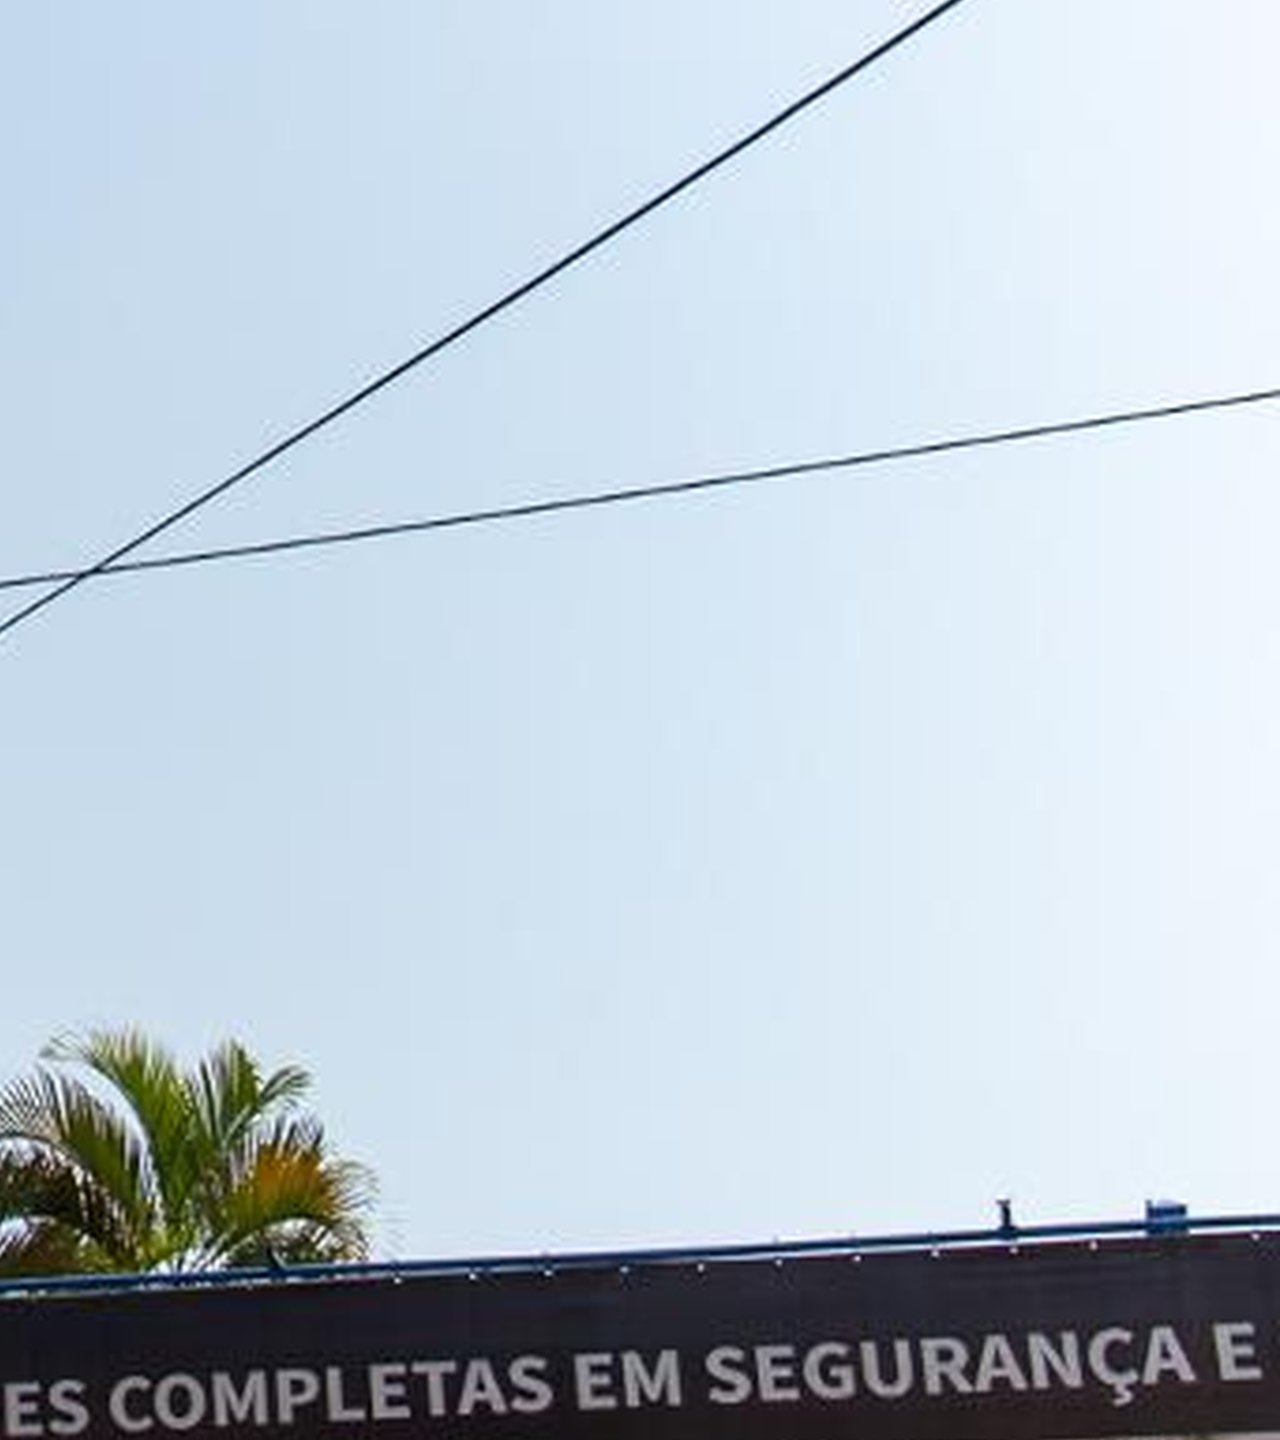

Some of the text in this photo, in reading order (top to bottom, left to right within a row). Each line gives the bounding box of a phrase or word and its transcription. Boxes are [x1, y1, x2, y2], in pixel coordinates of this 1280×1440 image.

[108, 1355, 554, 1431] COMPLETAS
[573, 1349, 683, 1411] EM
[705, 1326, 1197, 1406] SEGURANÇA
[1213, 1322, 1263, 1381] E
